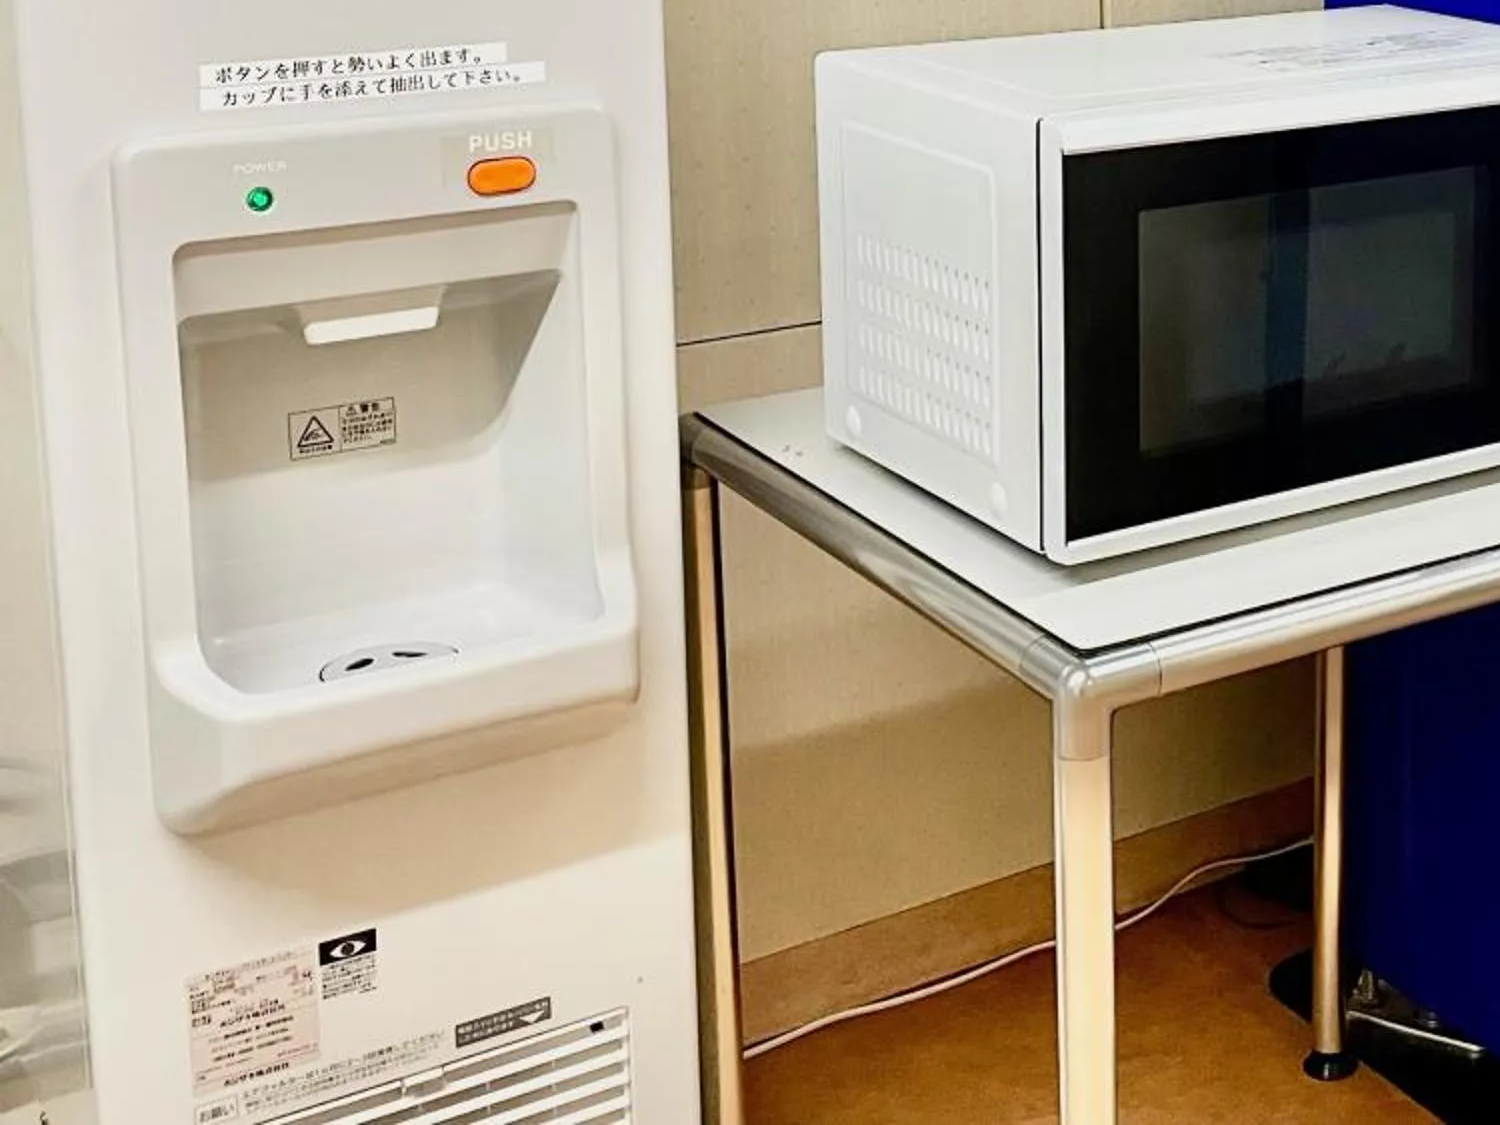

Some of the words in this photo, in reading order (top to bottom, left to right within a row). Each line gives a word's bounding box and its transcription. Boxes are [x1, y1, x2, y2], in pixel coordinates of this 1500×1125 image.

[216, 47, 483, 83] ボタンを押すと勢いよく出ます。
[222, 68, 522, 107] カップに手を添えて抽出して下さい。
[468, 130, 533, 153] PUSH
